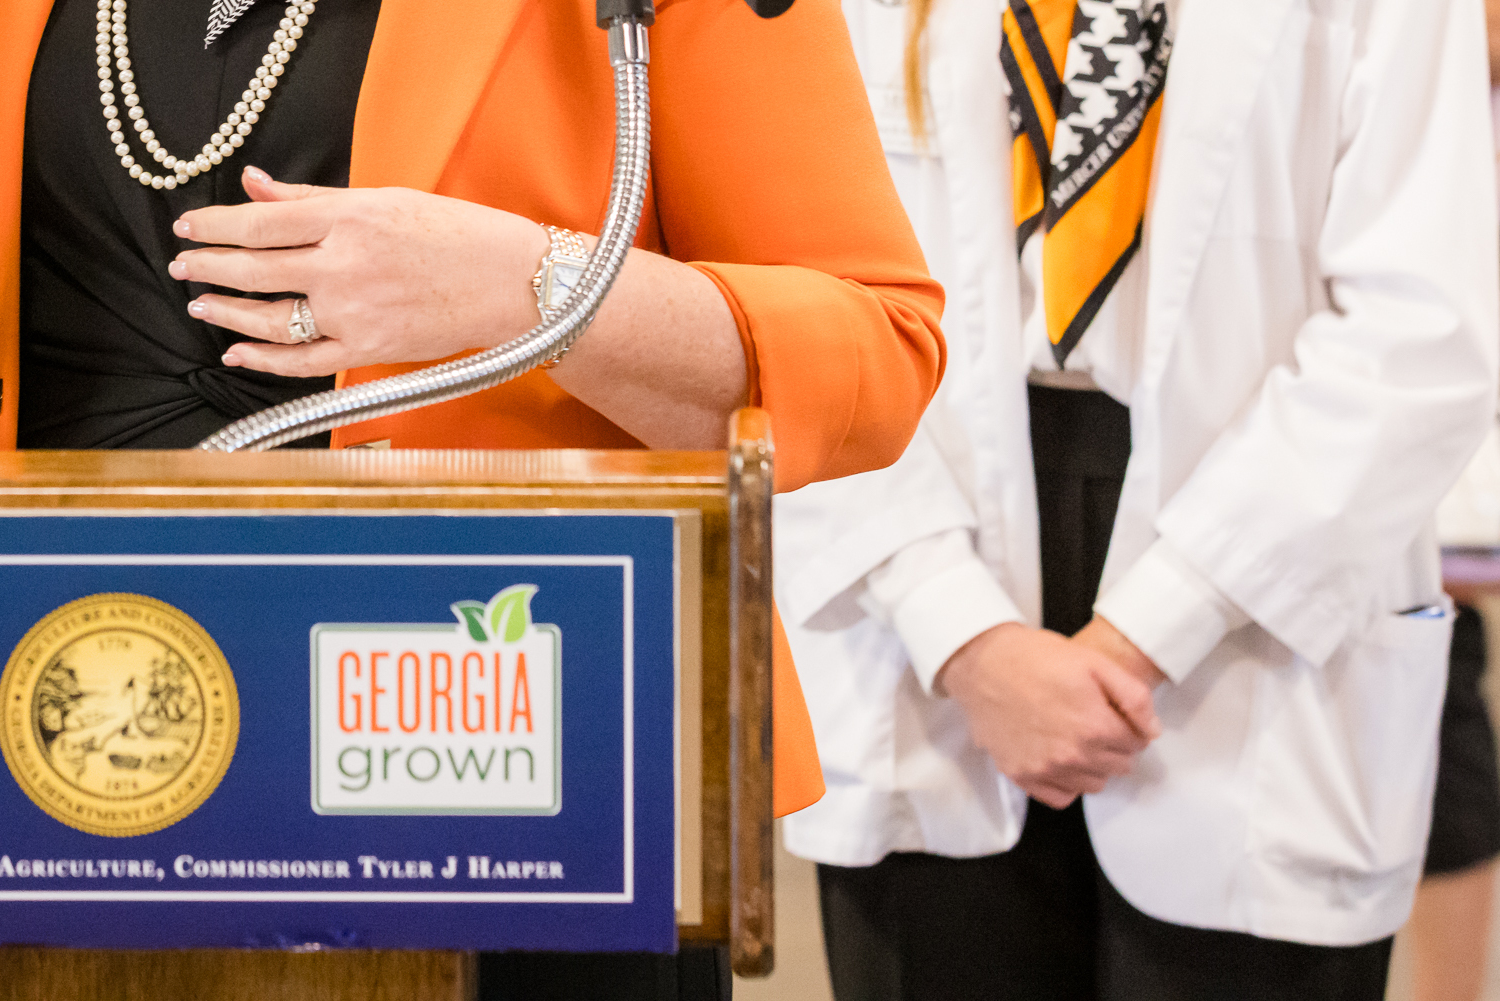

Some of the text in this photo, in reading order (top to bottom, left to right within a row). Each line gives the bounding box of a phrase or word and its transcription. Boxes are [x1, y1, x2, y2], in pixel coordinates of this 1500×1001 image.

[338, 651, 534, 734] GEORGIA
[337, 745, 535, 792] grown
[440, 856, 458, 879] J
